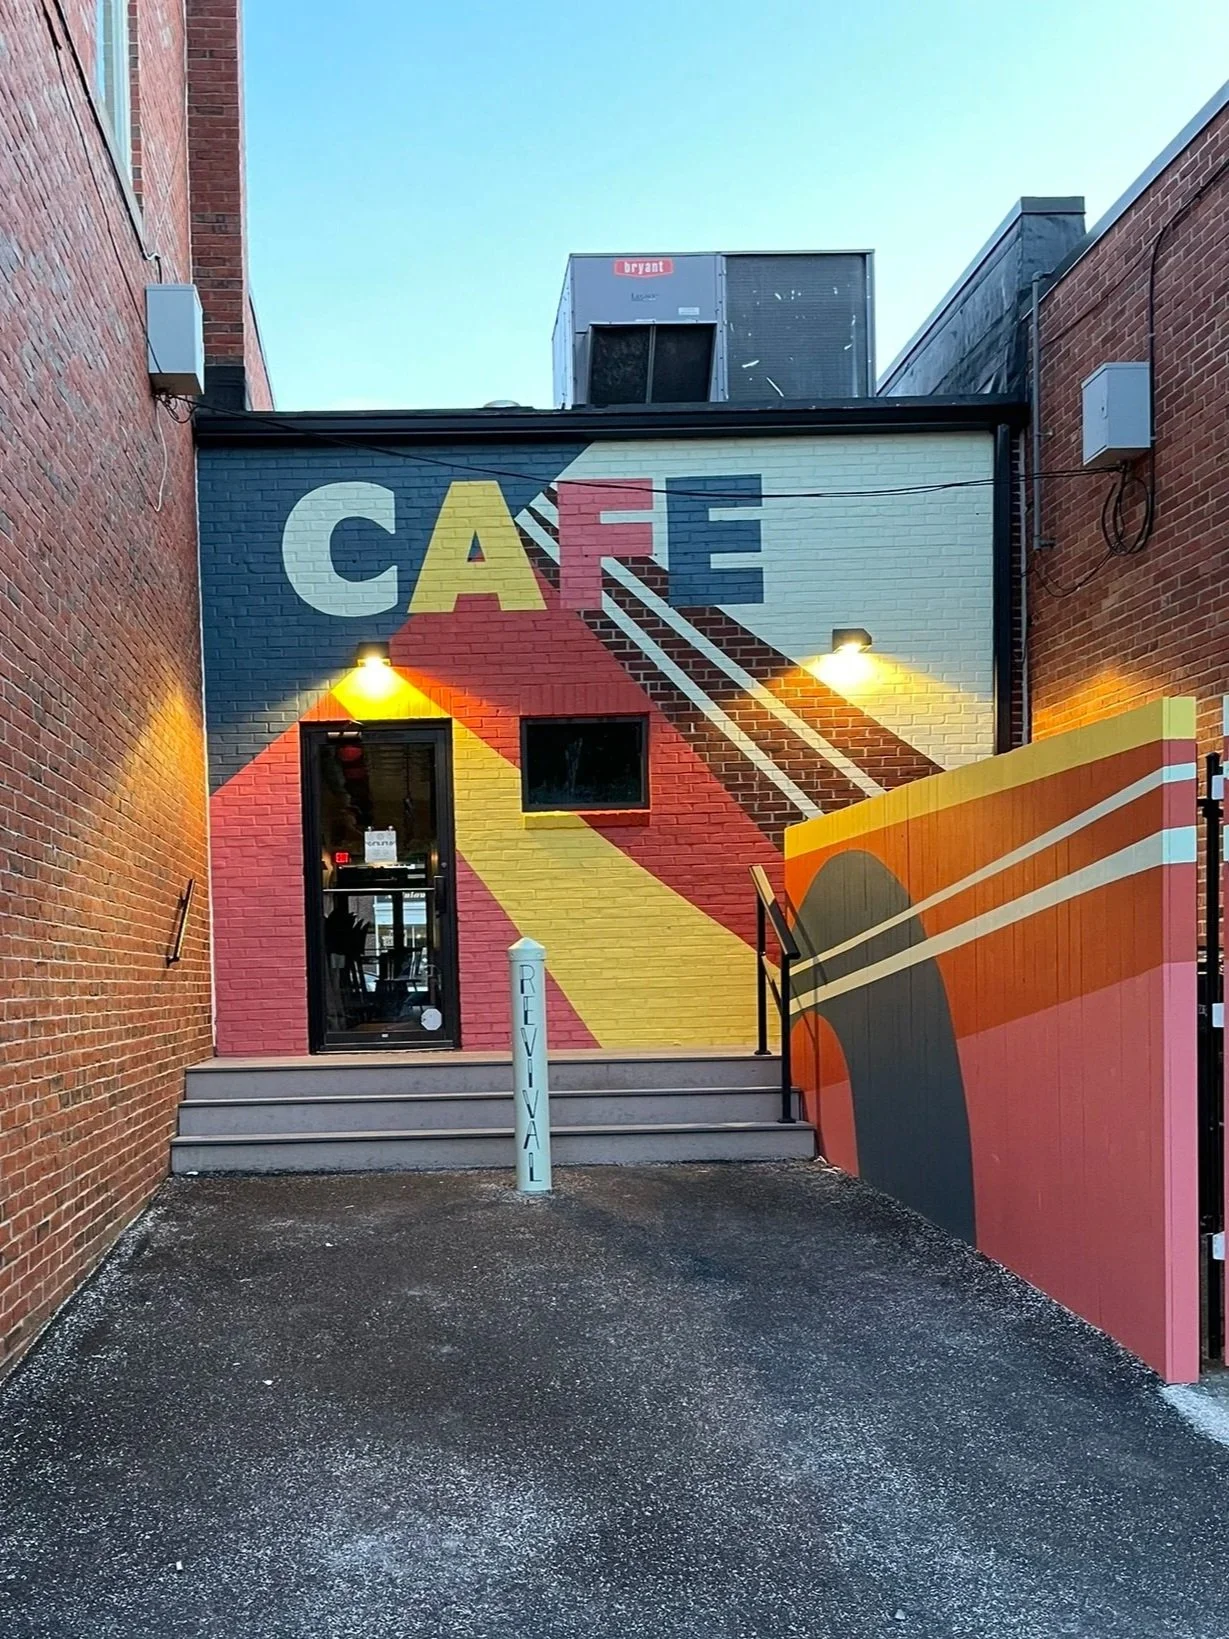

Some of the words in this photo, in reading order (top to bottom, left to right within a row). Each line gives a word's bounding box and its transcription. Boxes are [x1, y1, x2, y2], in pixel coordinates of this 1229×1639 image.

[624, 261, 664, 275] bryant
[281, 474, 764, 618] CAFE
[519, 964, 543, 1183] REVIVAL
